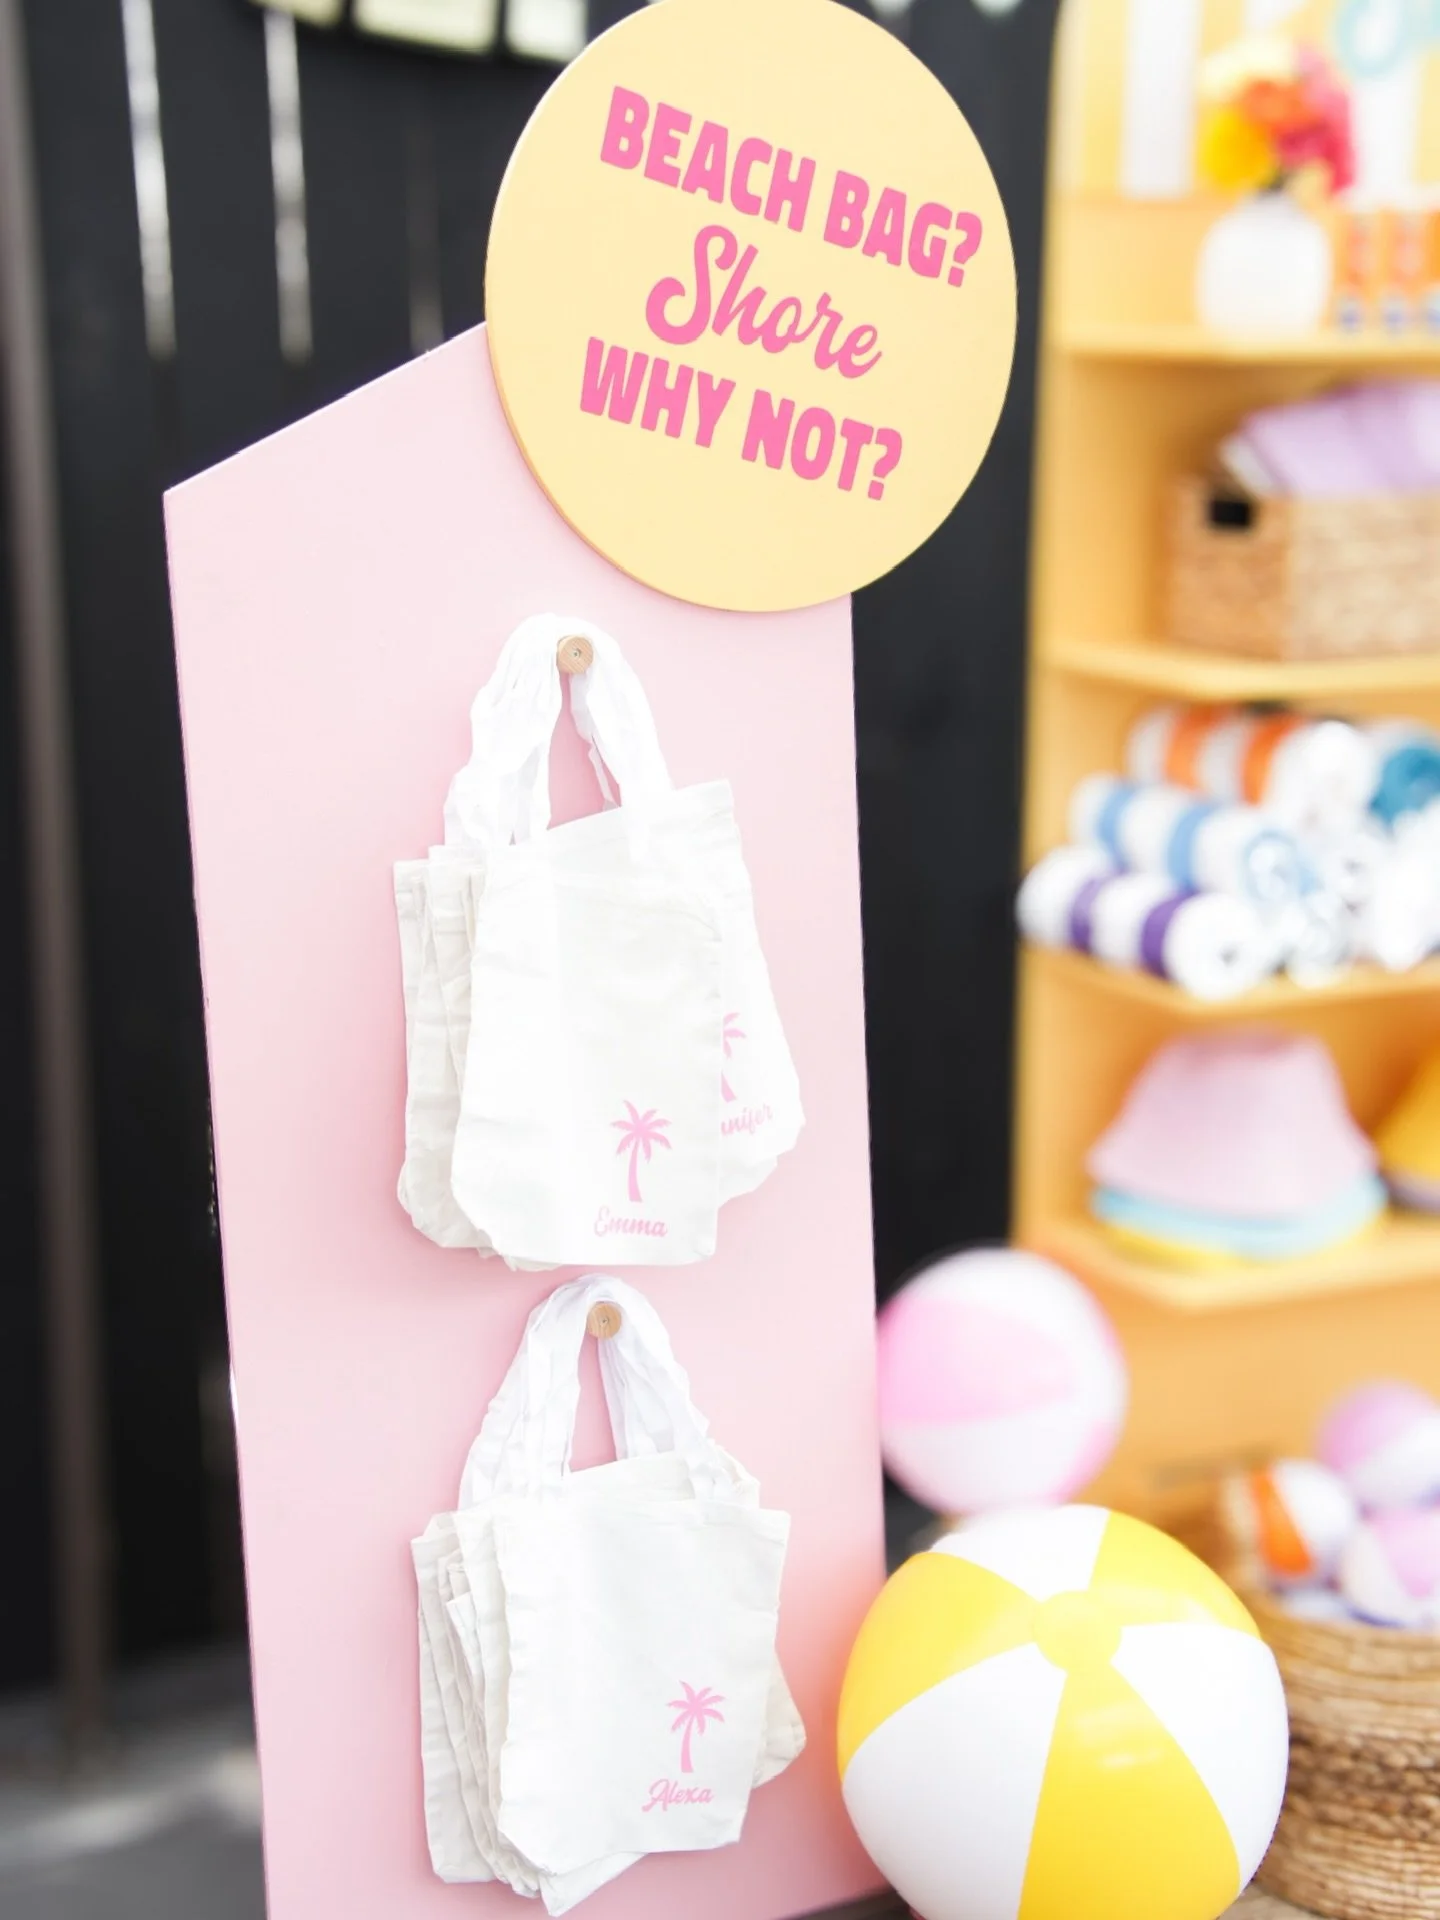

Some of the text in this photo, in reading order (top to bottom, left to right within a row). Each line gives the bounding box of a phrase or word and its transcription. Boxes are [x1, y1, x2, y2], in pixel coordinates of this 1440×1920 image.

[601, 86, 983, 287] BEACH BAG?
[646, 224, 882, 378] Shore
[580, 336, 903, 500] WHY NOT?
[720, 1102, 773, 1137] nifer
[594, 1205, 669, 1238] Emma
[641, 1778, 715, 1813] Alexa
